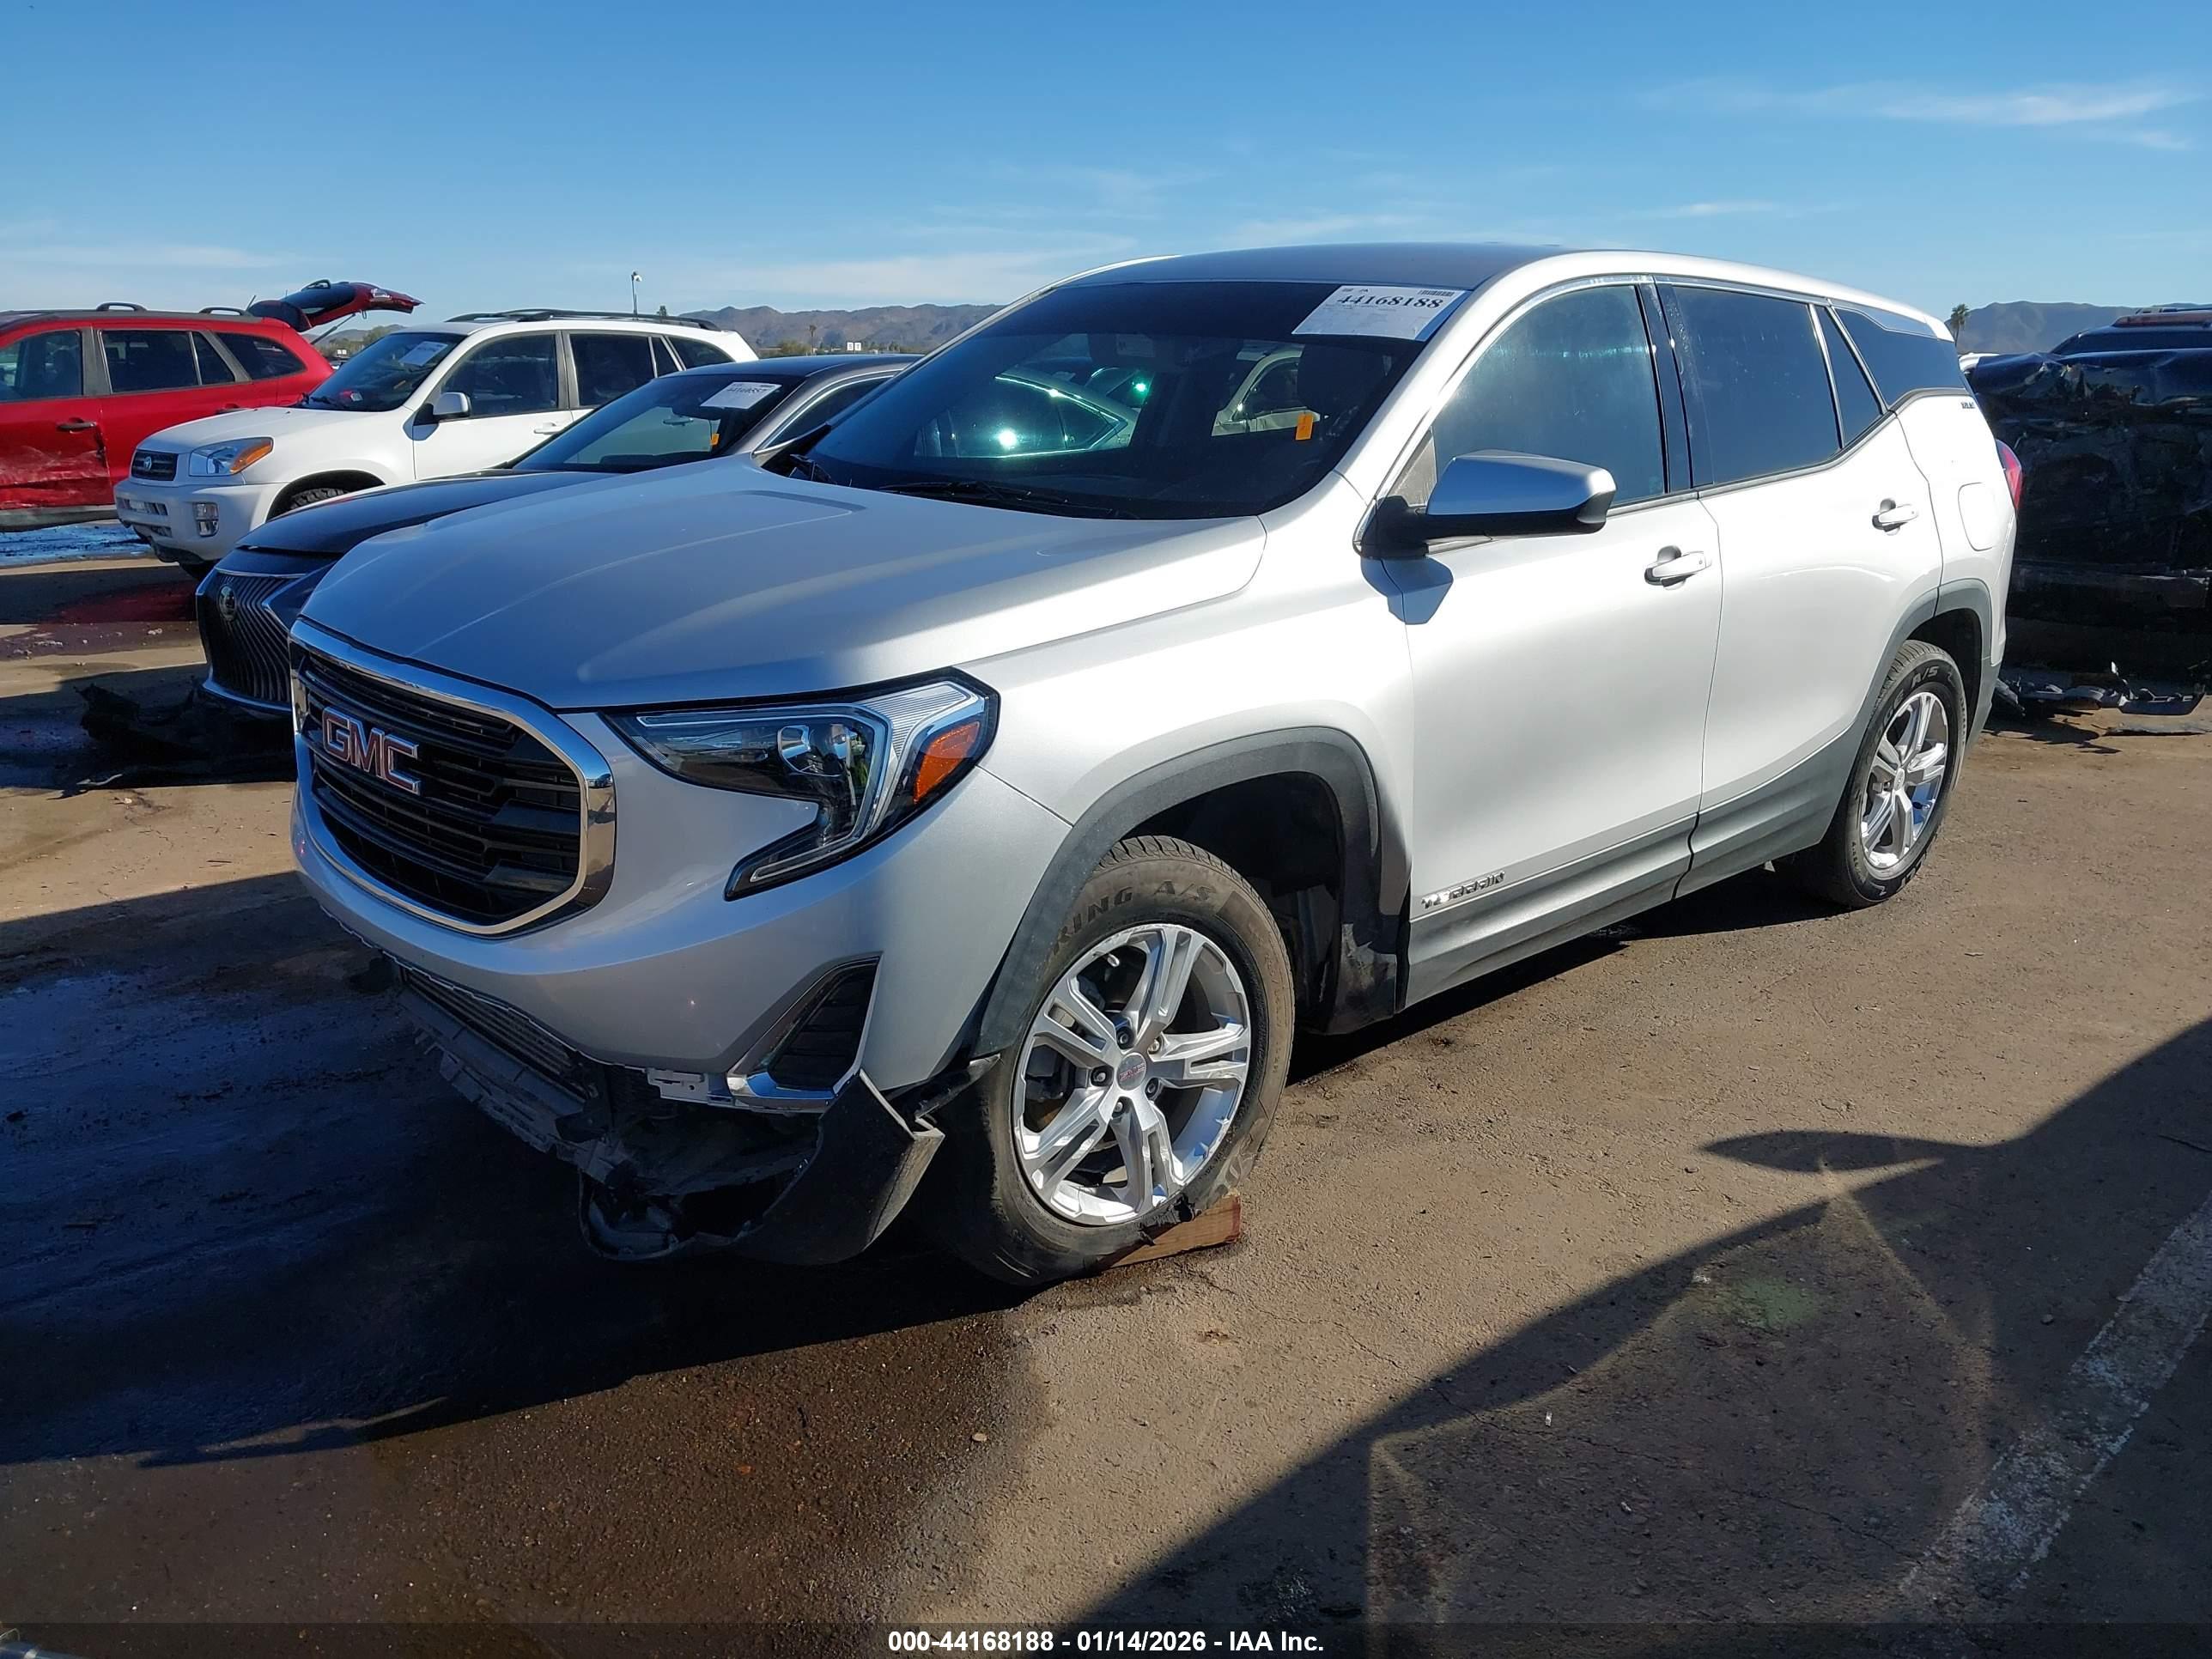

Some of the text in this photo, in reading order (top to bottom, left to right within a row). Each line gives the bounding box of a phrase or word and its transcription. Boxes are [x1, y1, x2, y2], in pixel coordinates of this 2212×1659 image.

[1337, 295, 1443, 308] 44168188
[1911, 665, 1939, 688] A/S
[322, 706, 421, 795] GMC
